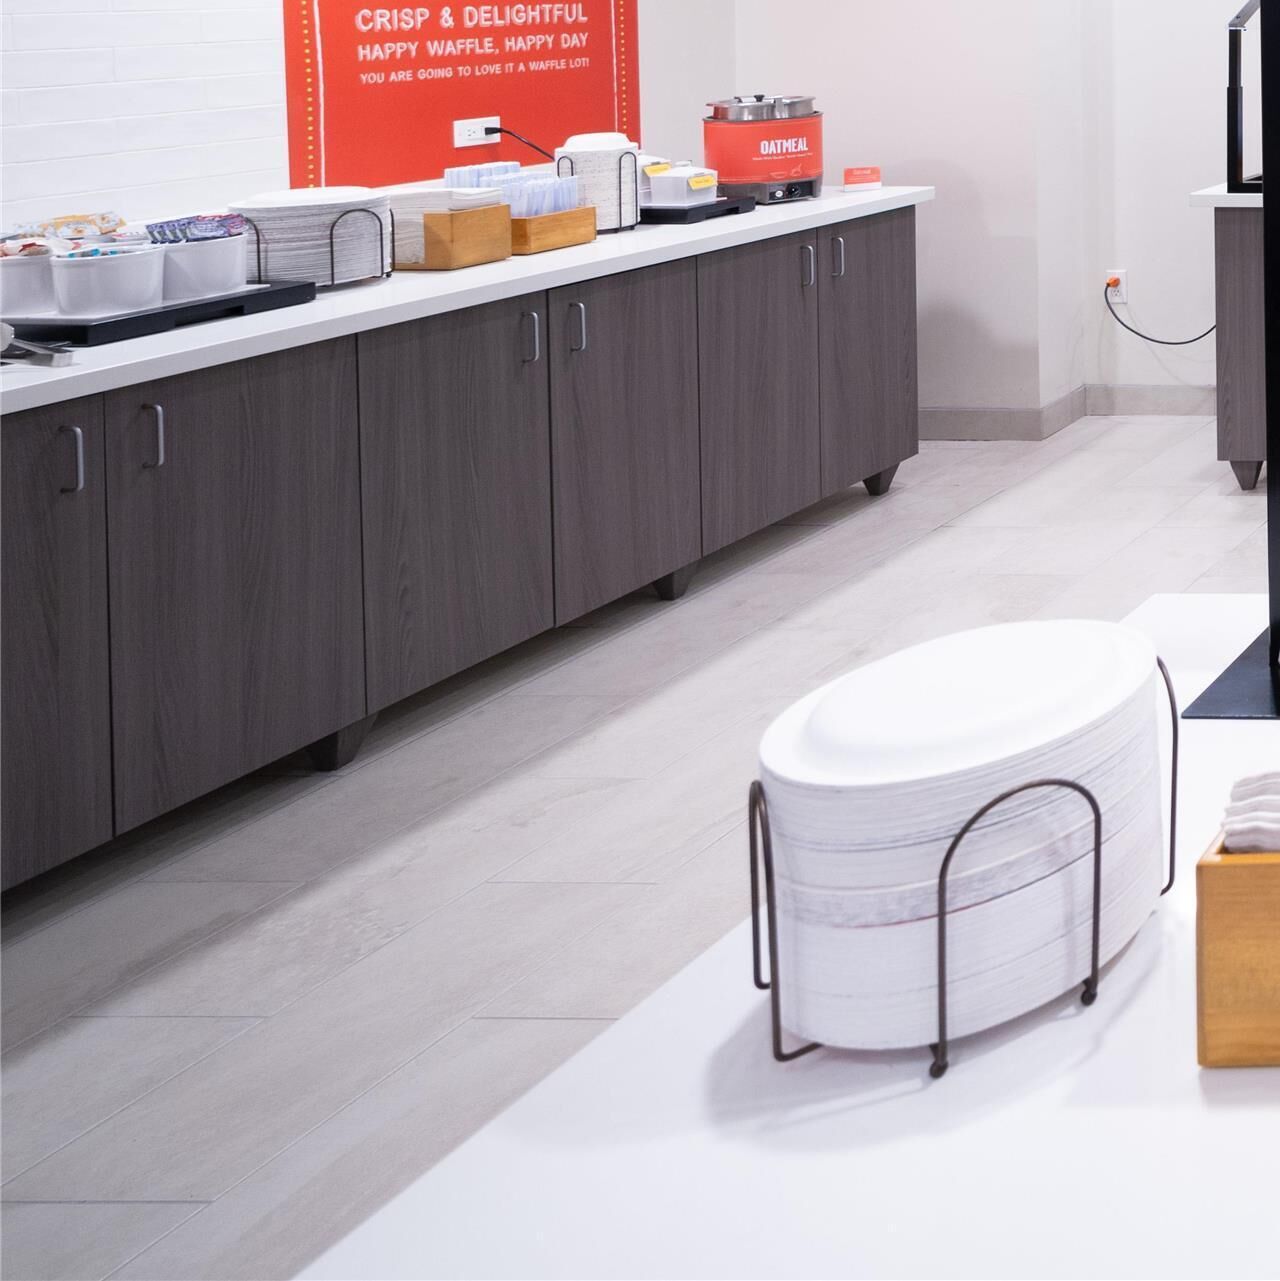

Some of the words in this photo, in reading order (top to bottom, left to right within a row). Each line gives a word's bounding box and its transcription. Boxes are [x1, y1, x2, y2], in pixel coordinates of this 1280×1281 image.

[355, 7, 430, 32] CRISP
[439, 6, 455, 29] &
[463, 2, 589, 29] DELIGHTFUL
[357, 41, 419, 62] HAPPY
[427, 37, 500, 57] WAFFLE,
[504, 35, 554, 53] HAPPY
[561, 32, 589, 49] DAY
[360, 72, 385, 84] YOU
[389, 70, 413, 82] ARE
[418, 67, 453, 80] GOING
[457, 66, 472, 77] TO
[475, 63, 501, 76] LOVE
[505, 63, 514, 73] IT
[518, 62, 525, 73] A
[529, 59, 567, 71] WAFFLE
[569, 57, 590, 69] LOT!
[760, 136, 808, 155] OATMEAL
